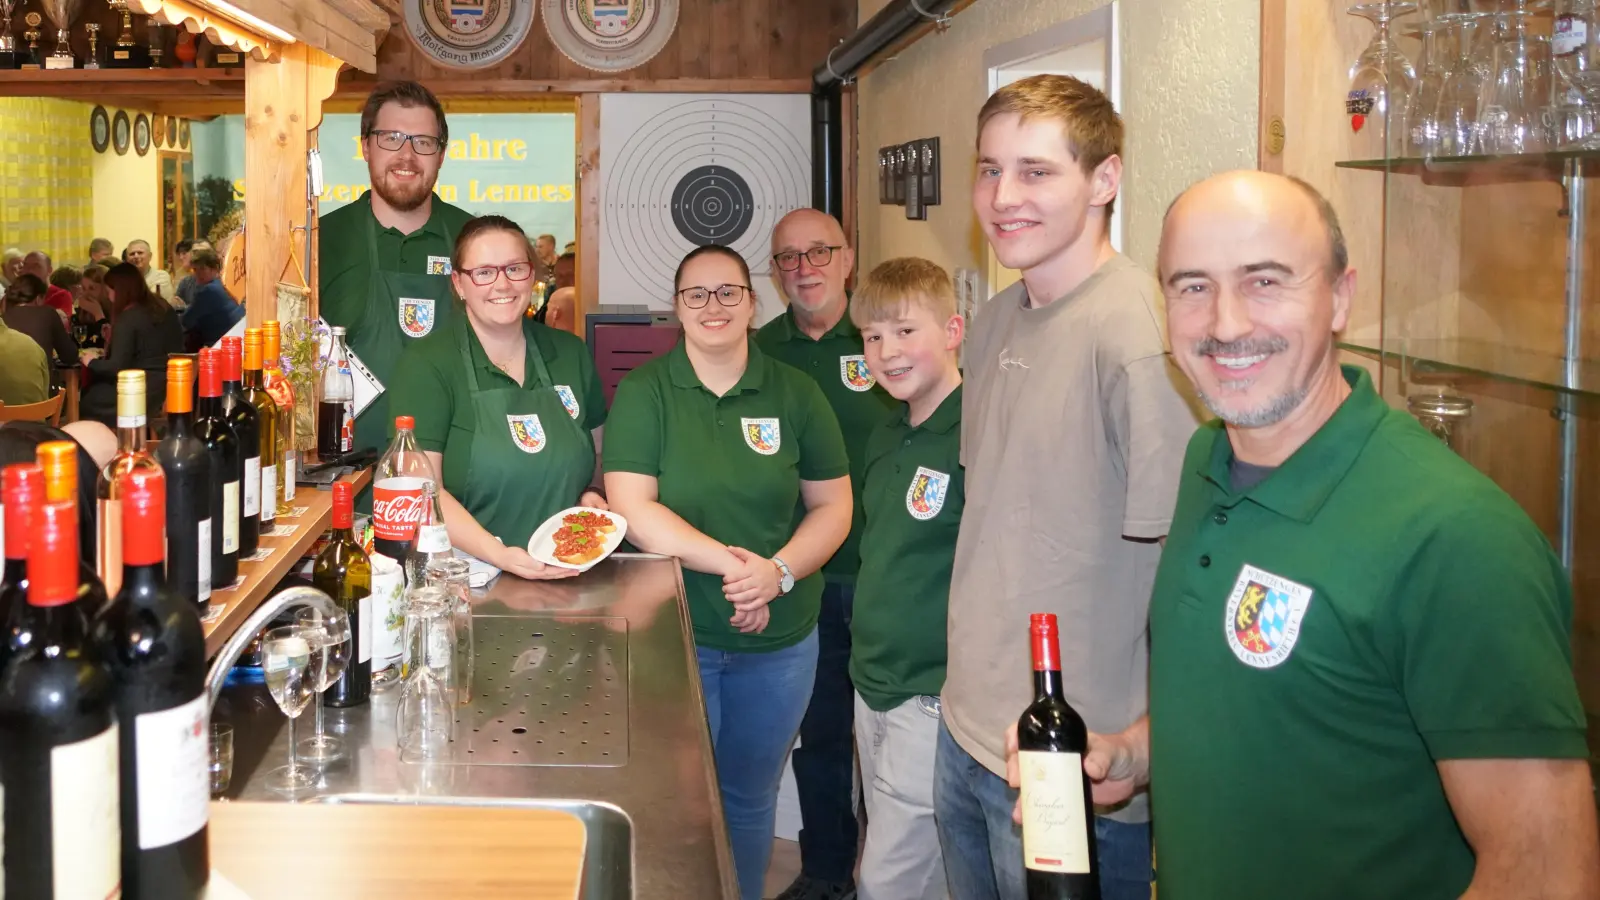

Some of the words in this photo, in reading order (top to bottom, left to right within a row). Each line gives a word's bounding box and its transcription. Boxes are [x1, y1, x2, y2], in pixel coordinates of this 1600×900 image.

[418, 30, 468, 64] Wolfgang
[449, 133, 527, 161] ahre
[374, 495, 423, 522] ca-Cola
